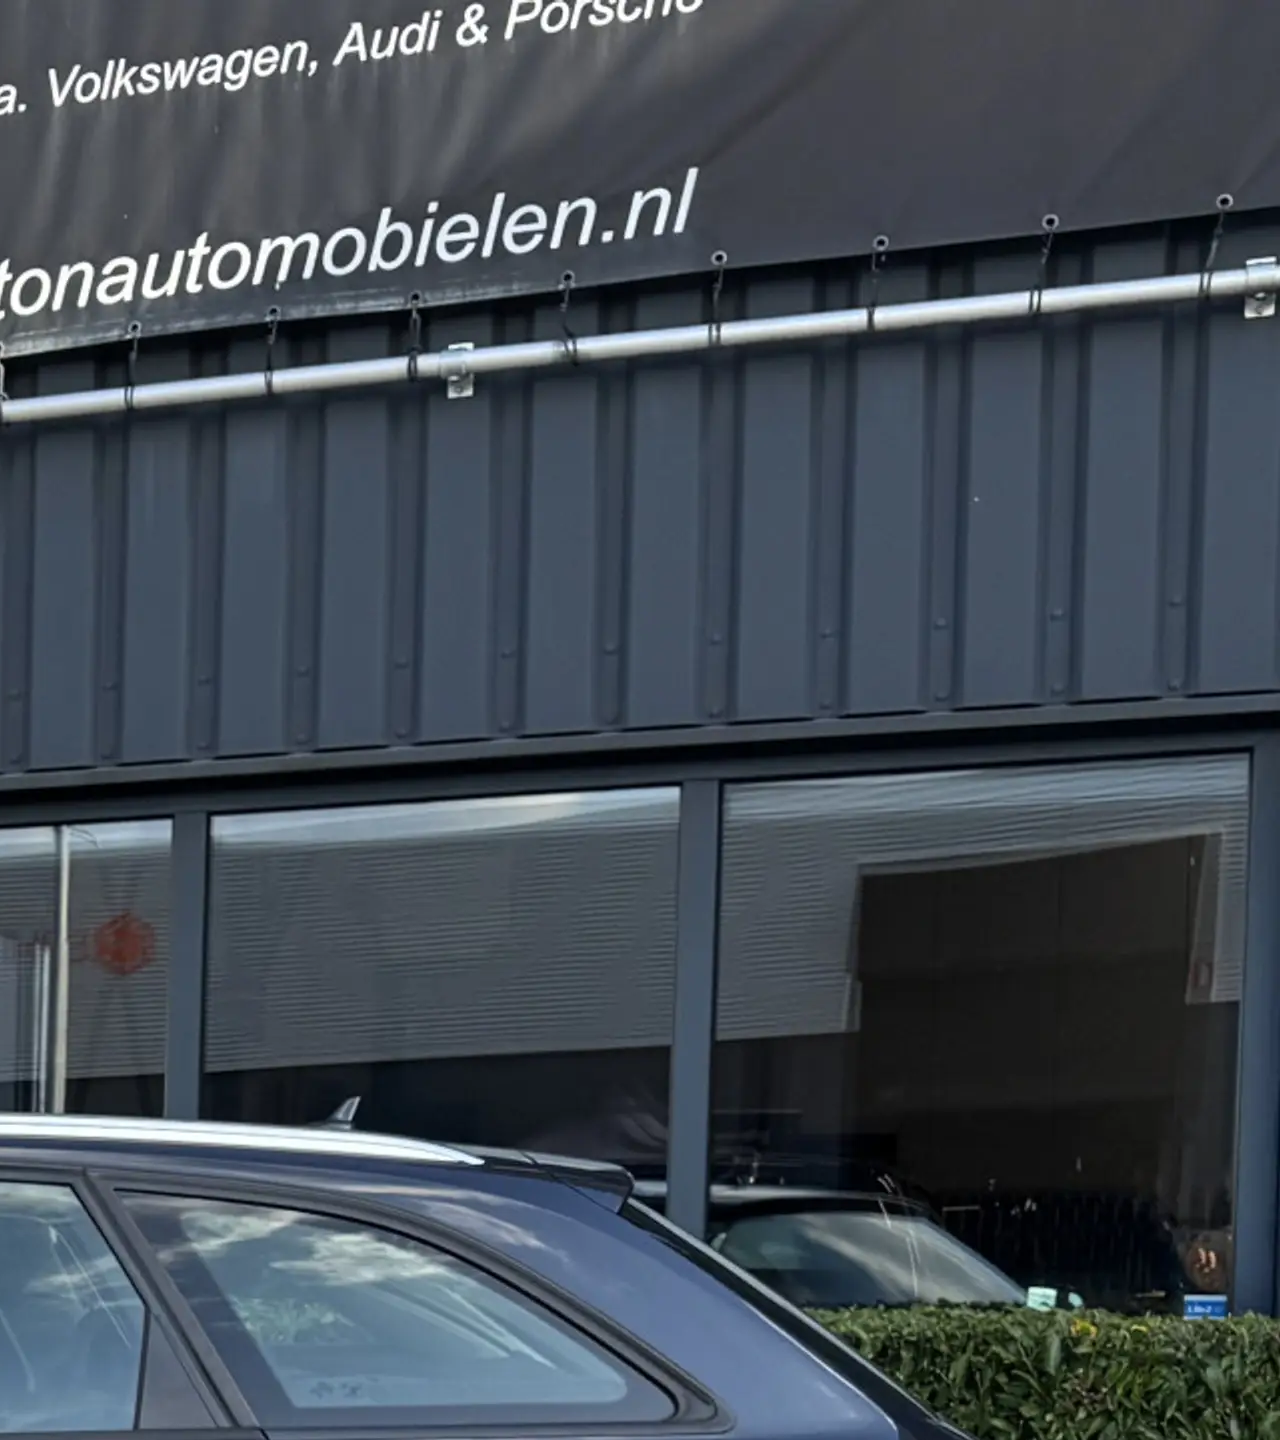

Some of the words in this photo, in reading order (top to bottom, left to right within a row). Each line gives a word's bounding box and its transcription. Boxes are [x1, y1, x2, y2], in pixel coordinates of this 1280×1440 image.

[48, 40, 318, 108] Volkswagen,
[332, 10, 443, 67] Audi
[455, 3, 489, 48] &
